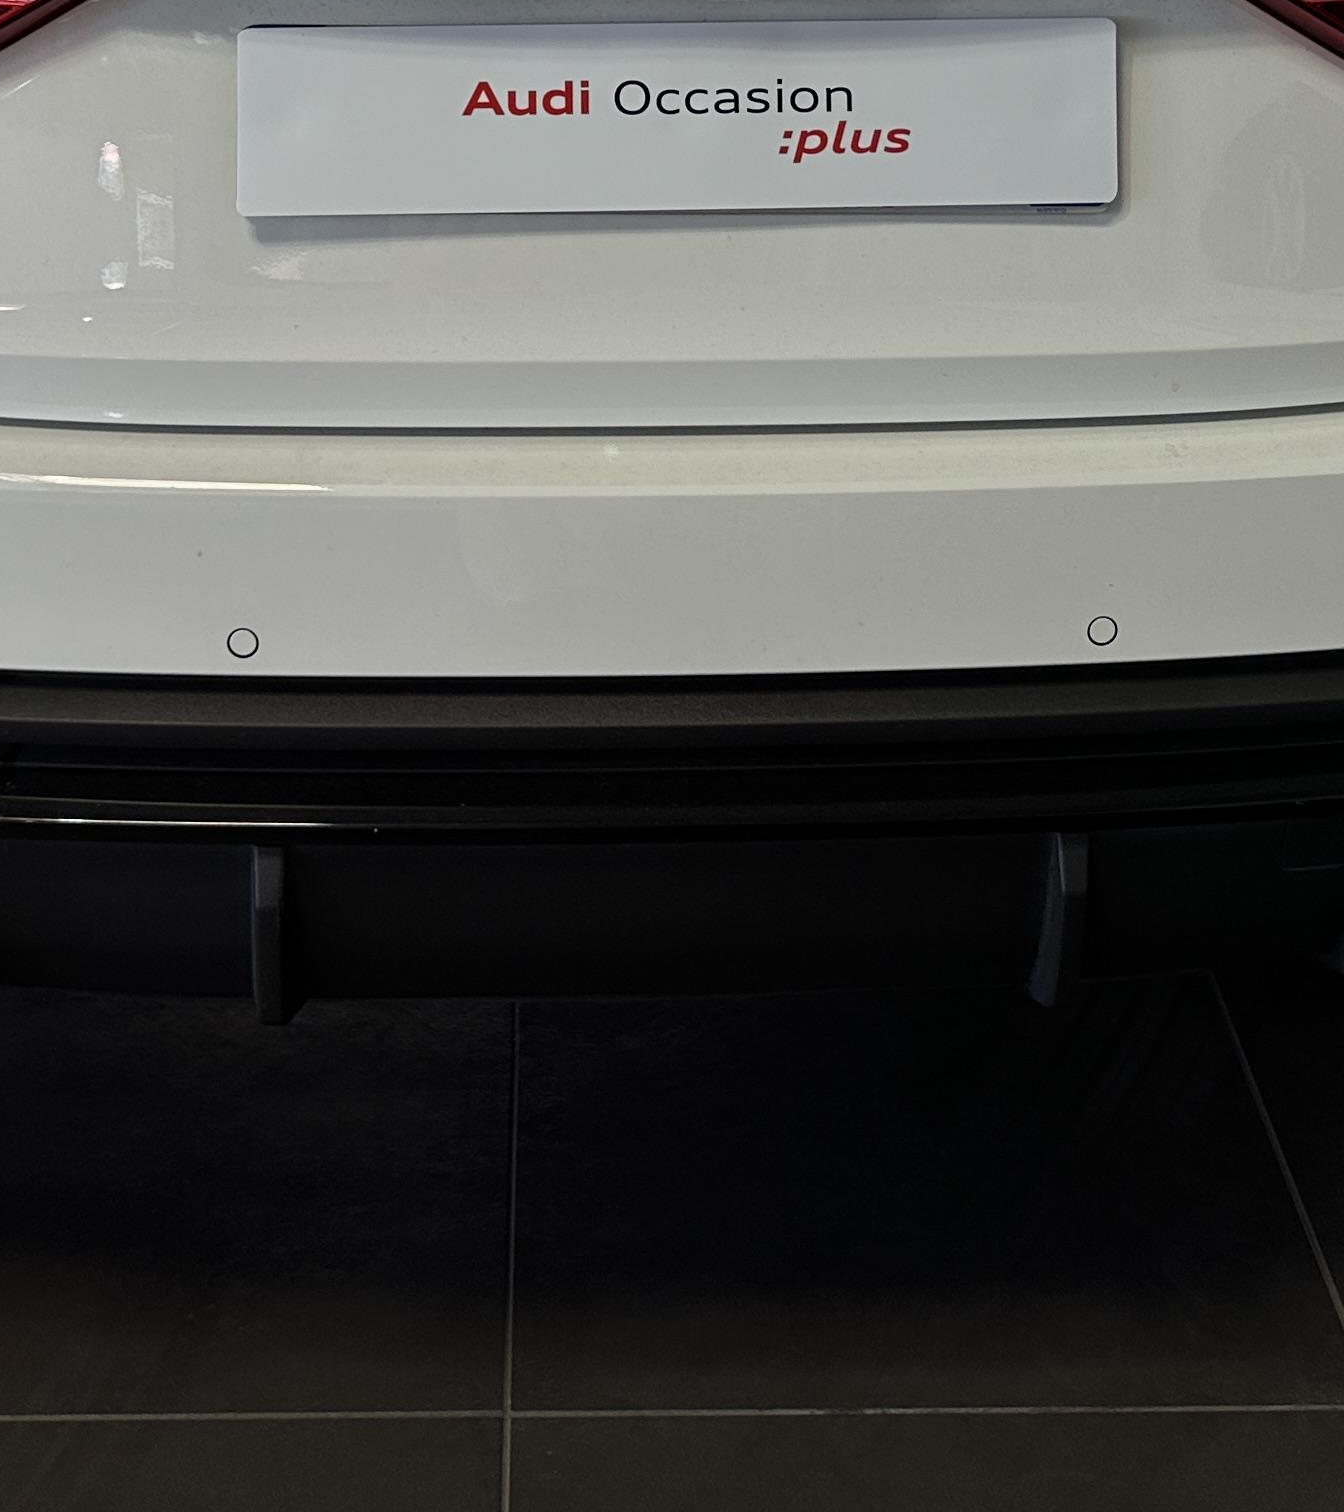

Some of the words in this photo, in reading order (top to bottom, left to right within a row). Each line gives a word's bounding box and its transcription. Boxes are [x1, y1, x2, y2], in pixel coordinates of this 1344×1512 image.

[462, 80, 591, 116] Audi
[614, 78, 854, 115] Occasion
[778, 120, 912, 163] :plus
